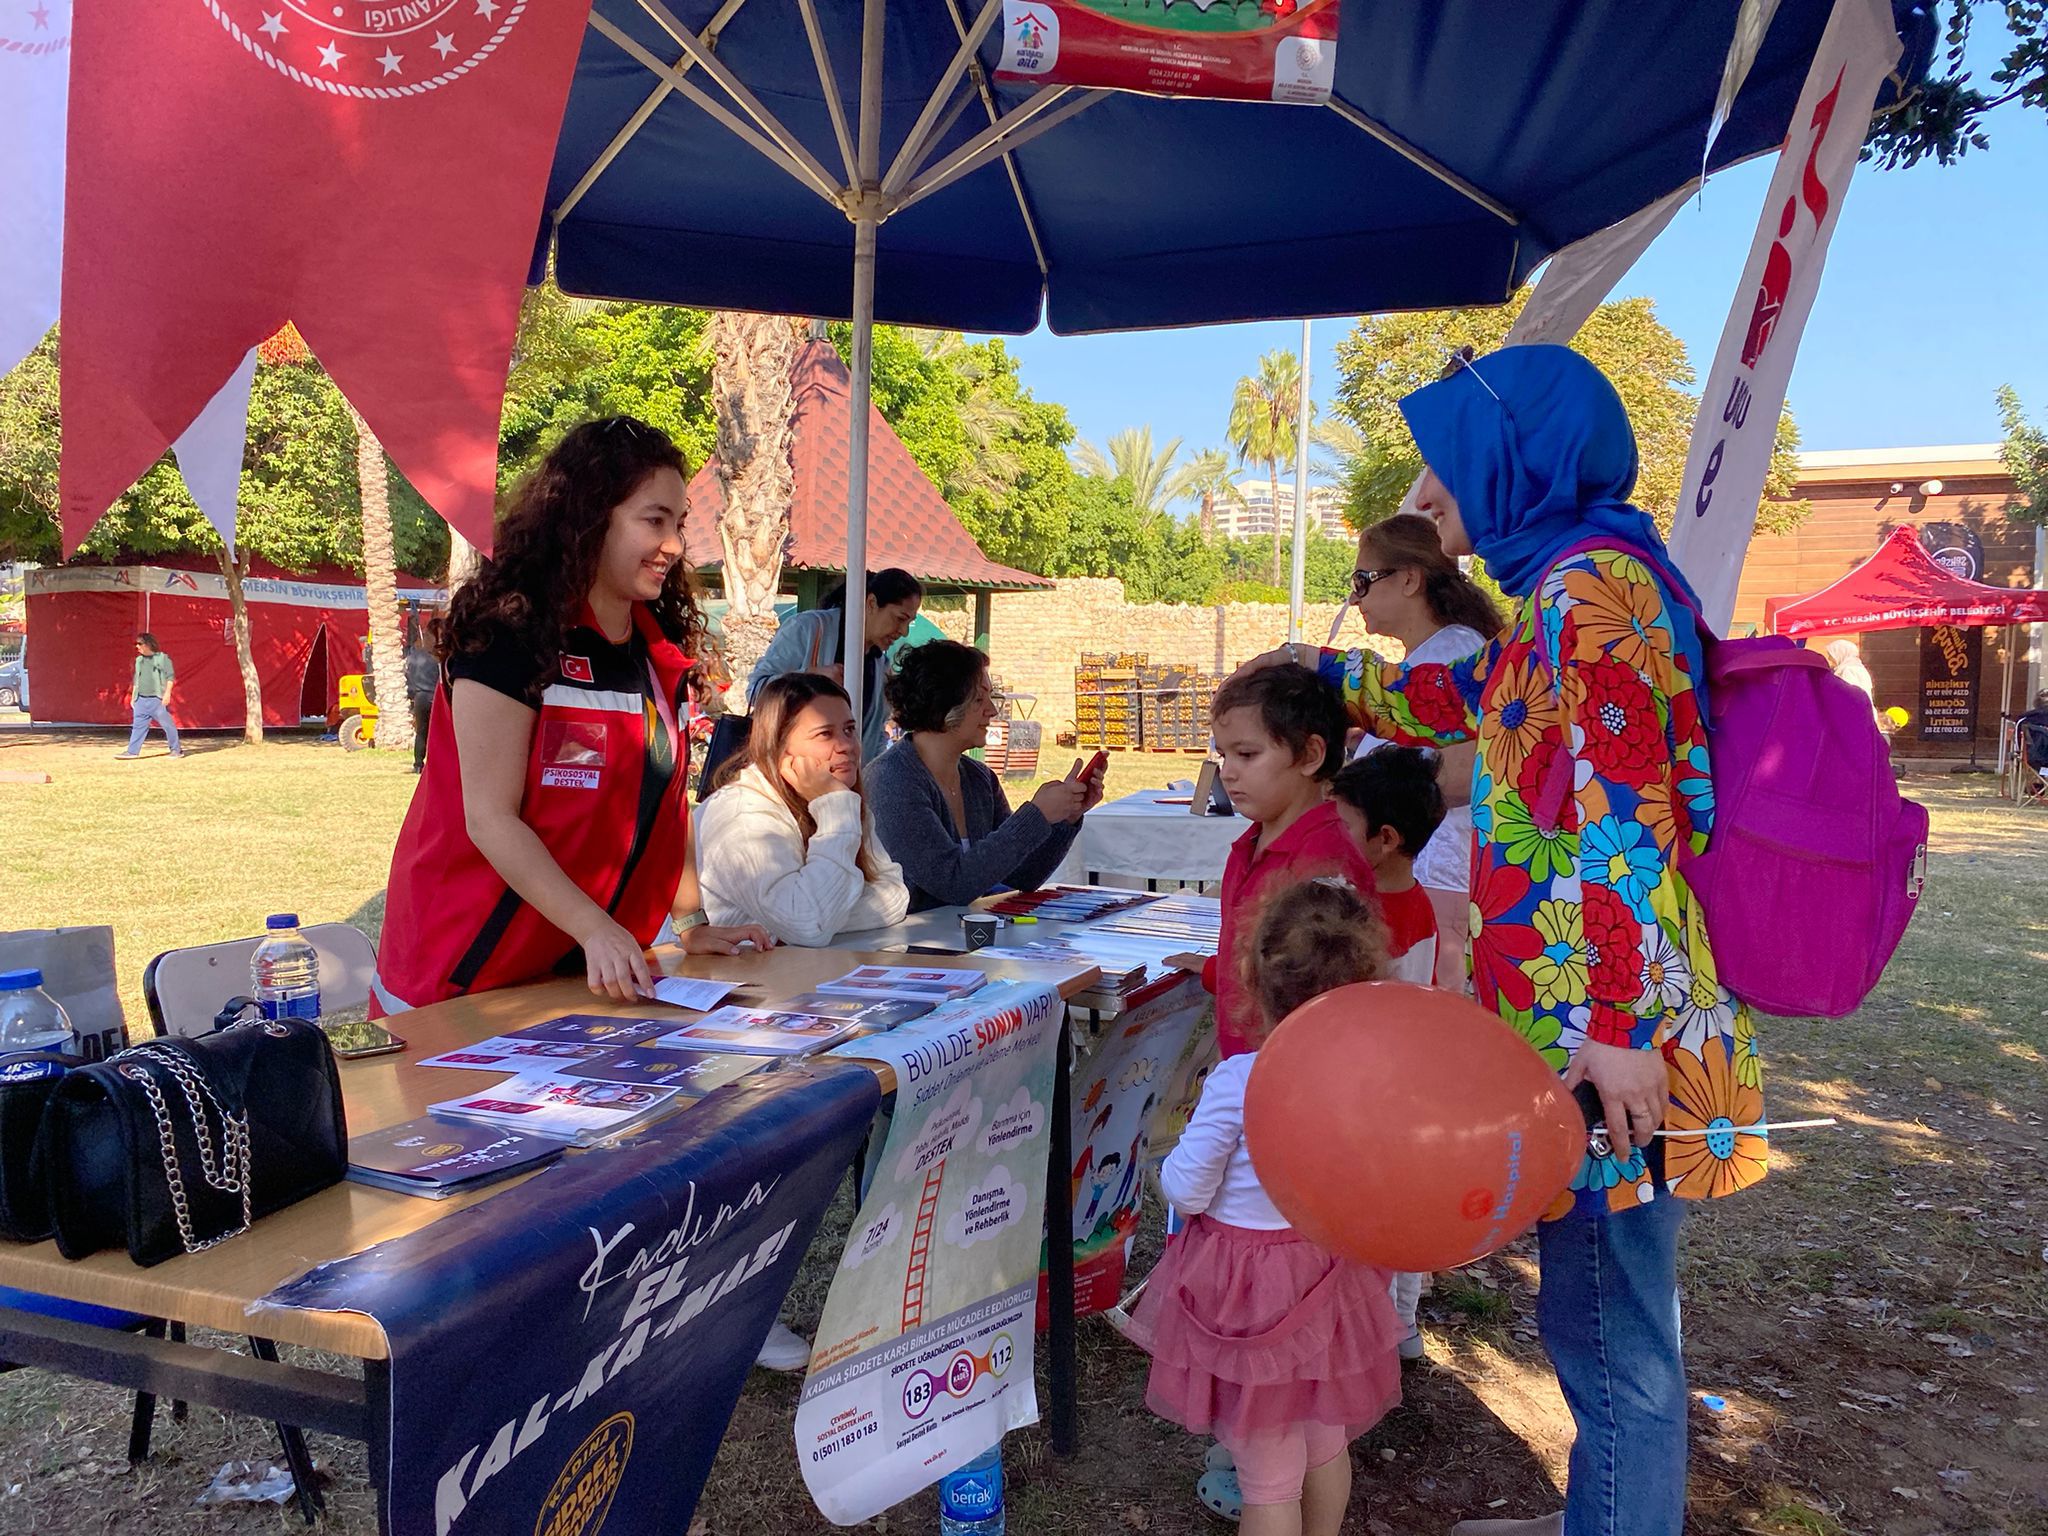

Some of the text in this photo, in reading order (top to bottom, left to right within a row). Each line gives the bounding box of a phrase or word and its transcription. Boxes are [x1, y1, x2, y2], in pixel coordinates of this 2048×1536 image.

[243, 580, 288, 595] MERSİN
[291, 585, 365, 603] BÜYÜKŞEHİR
[1823, 604, 2006, 627] T.C. MERSİN BÜYÜKŞEHİR BELEDİYESİ
[553, 778, 585, 789] DESTEK
[901, 991, 1054, 1083] BU İLDE ŞÖNİM VAR!
[987, 1122, 1034, 1147] Yönlendirme
[914, 1133, 957, 1172] DESTEK
[972, 1187, 1006, 1206] Danışma,
[964, 1210, 1010, 1236] ve Rehberlik
[965, 1198, 1011, 1222] Yönlendirme
[865, 1217, 890, 1244] 7/24
[579, 1173, 783, 1322] Kadına
[620, 1257, 689, 1332] EL
[805, 1372, 842, 1400] KADINA
[843, 1355, 883, 1384] ŞİDDETE
[883, 1342, 910, 1364] KARŞI
[910, 1324, 946, 1348] BİRLİKTE
[946, 1308, 991, 1334] MÜCADELE
[990, 1288, 1033, 1313] EDİYORUZ!
[890, 1357, 917, 1378] ŞİDDETE
[917, 1336, 966, 1364] UĞRADIĞINIZDA
[991, 1345, 1012, 1369] 112
[906, 1381, 931, 1407] 183
[816, 1410, 874, 1443] SOSYAL DESTEK HATTI
[830, 1406, 858, 1427] ÇEVRİMİÇİ
[812, 1421, 878, 1462] 0 (501) 183 0 183
[951, 1488, 992, 1505] berrak
